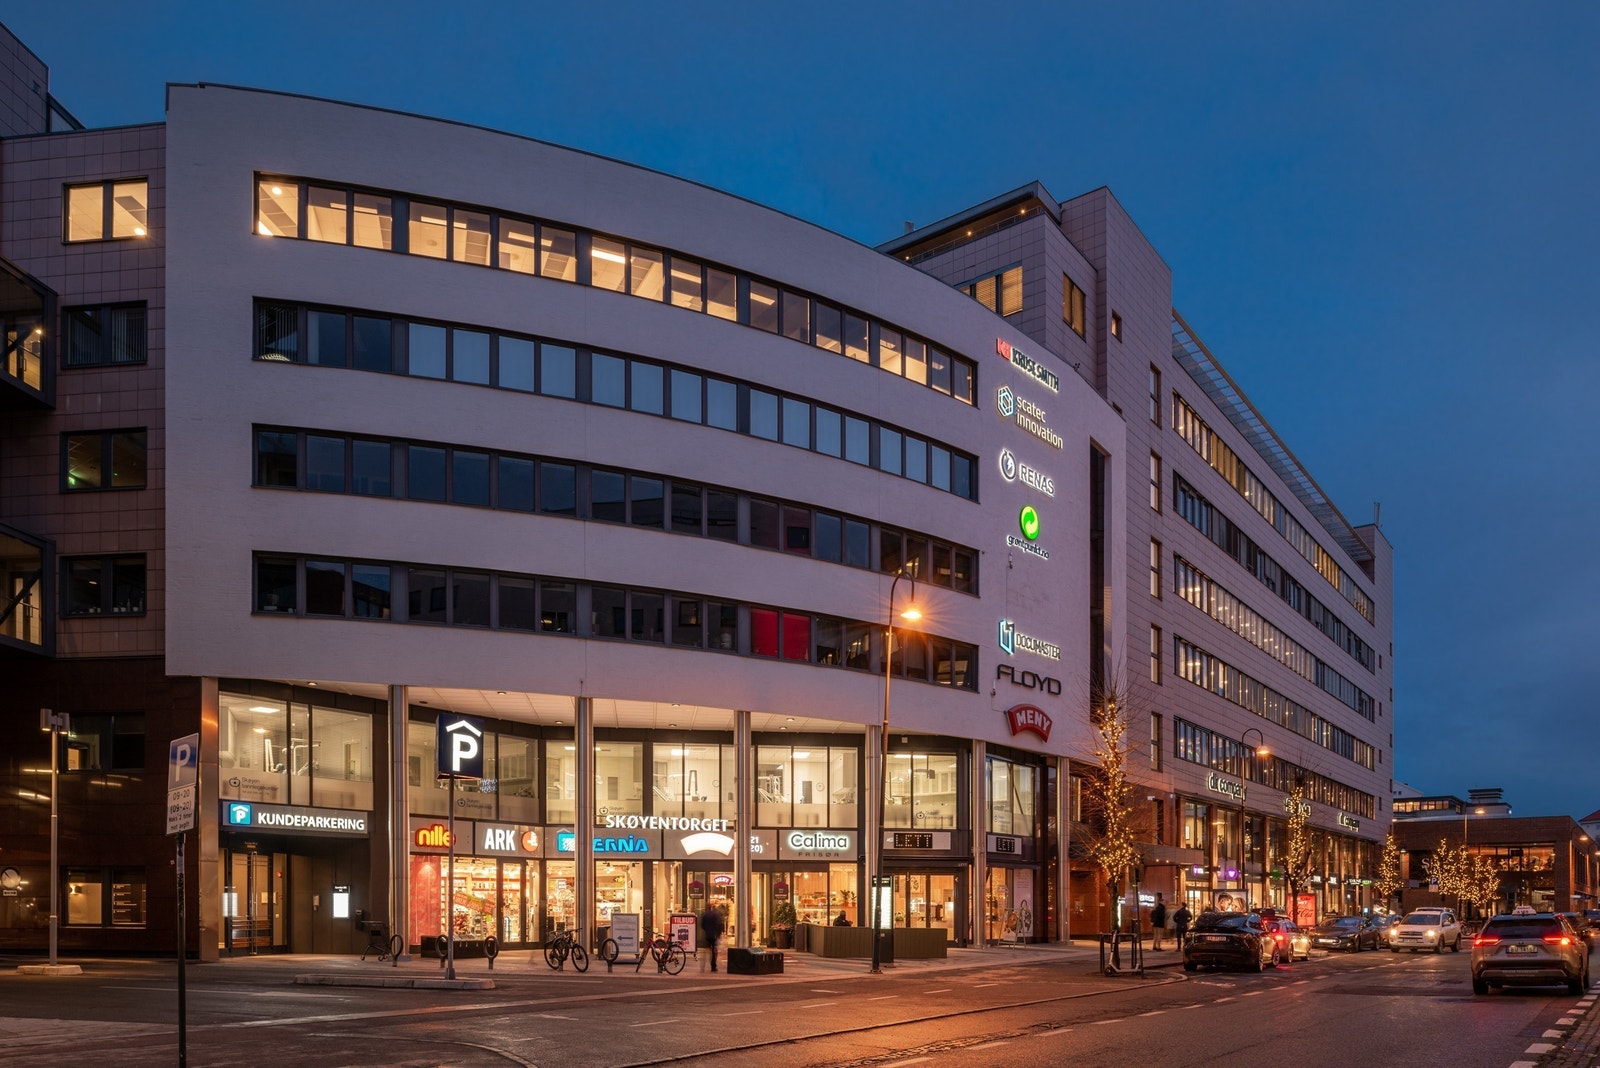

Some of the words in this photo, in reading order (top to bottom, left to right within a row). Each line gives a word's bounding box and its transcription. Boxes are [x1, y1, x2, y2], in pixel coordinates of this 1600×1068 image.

[1035, 364, 1059, 392] SMITH
[1016, 396, 1046, 423] scatec
[1016, 410, 1064, 449] innovation
[1019, 463, 1055, 495] RENAS
[1015, 632, 1061, 660] DOCUMASTER
[997, 664, 1062, 695] FLOYD
[1016, 709, 1050, 731] MENY
[175, 743, 191, 782] P
[452, 733, 478, 772] P
[236, 810, 247, 823] P
[258, 812, 365, 831] KUNDEPARKERING
[605, 814, 729, 832] SKØYENTORGET
[416, 824, 453, 848] nille
[484, 828, 516, 851] ARK
[790, 833, 848, 849] Calima
[674, 916, 694, 924] TILBUD
